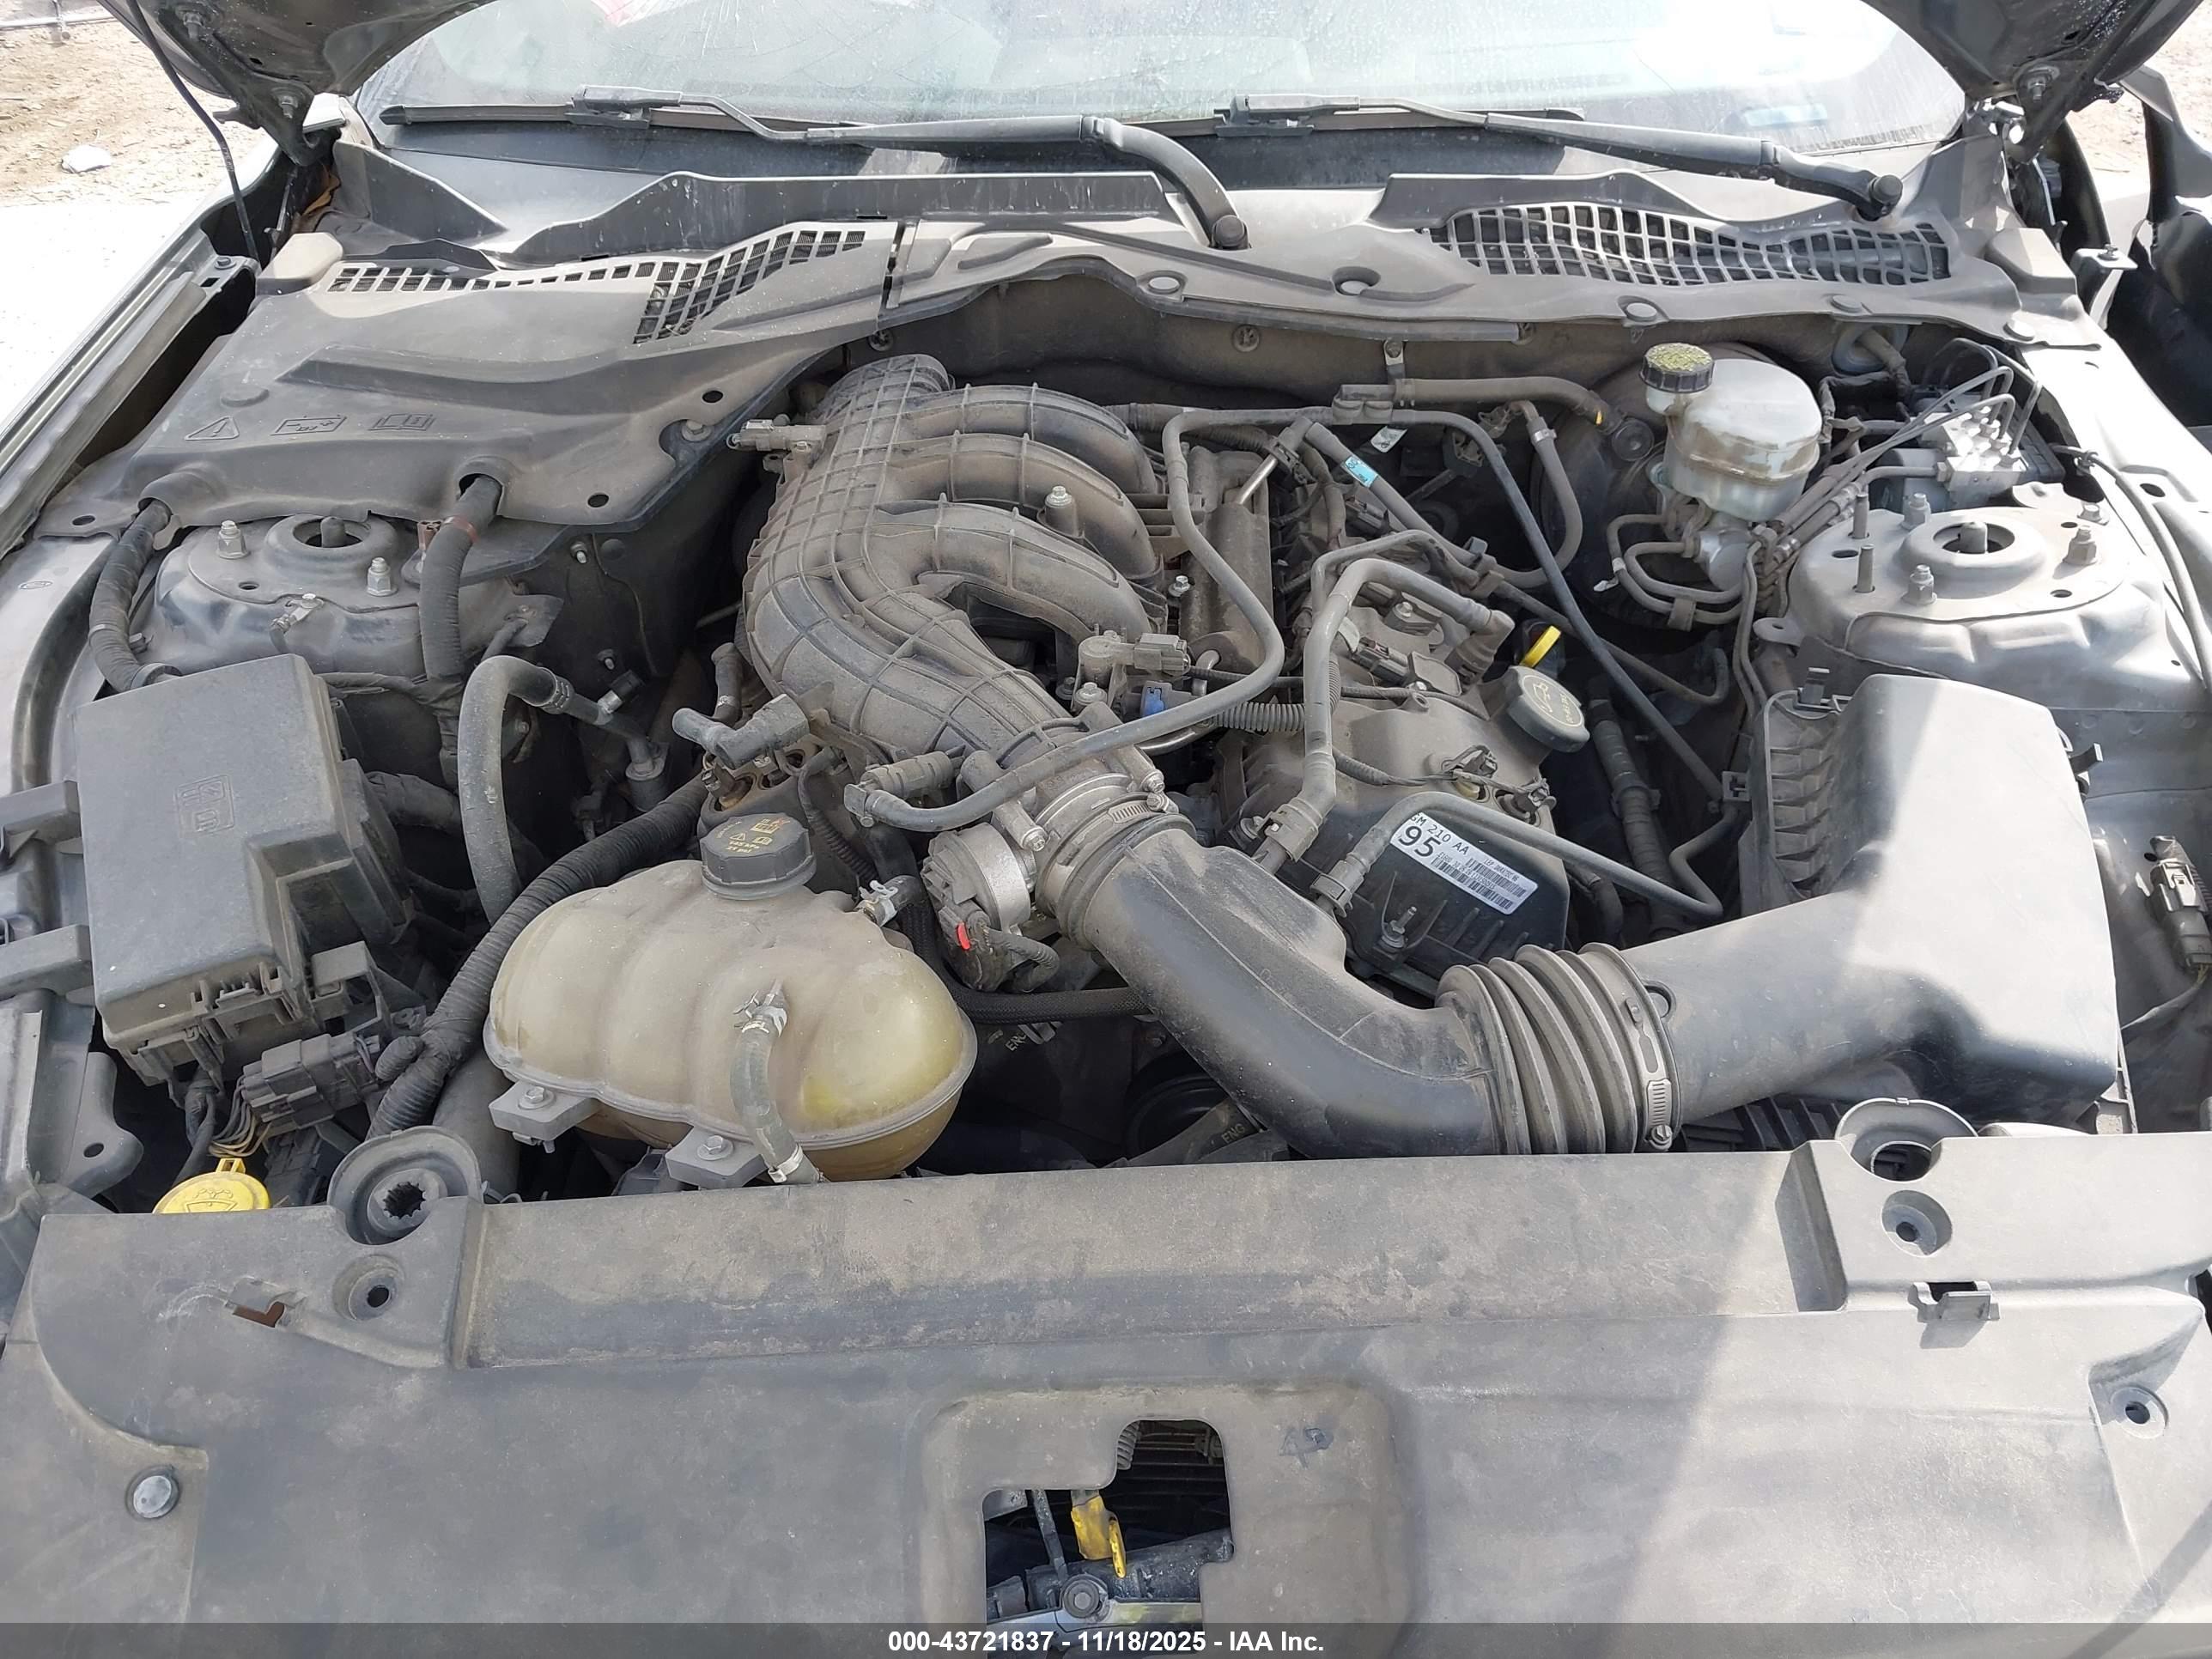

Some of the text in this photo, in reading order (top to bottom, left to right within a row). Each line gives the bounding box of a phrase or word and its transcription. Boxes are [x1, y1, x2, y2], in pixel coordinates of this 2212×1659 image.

[1398, 825, 1441, 858] 95
[1427, 824, 1451, 842] 210
[1453, 841, 1469, 855] AA
[1221, 1123, 1245, 1144] ENG
